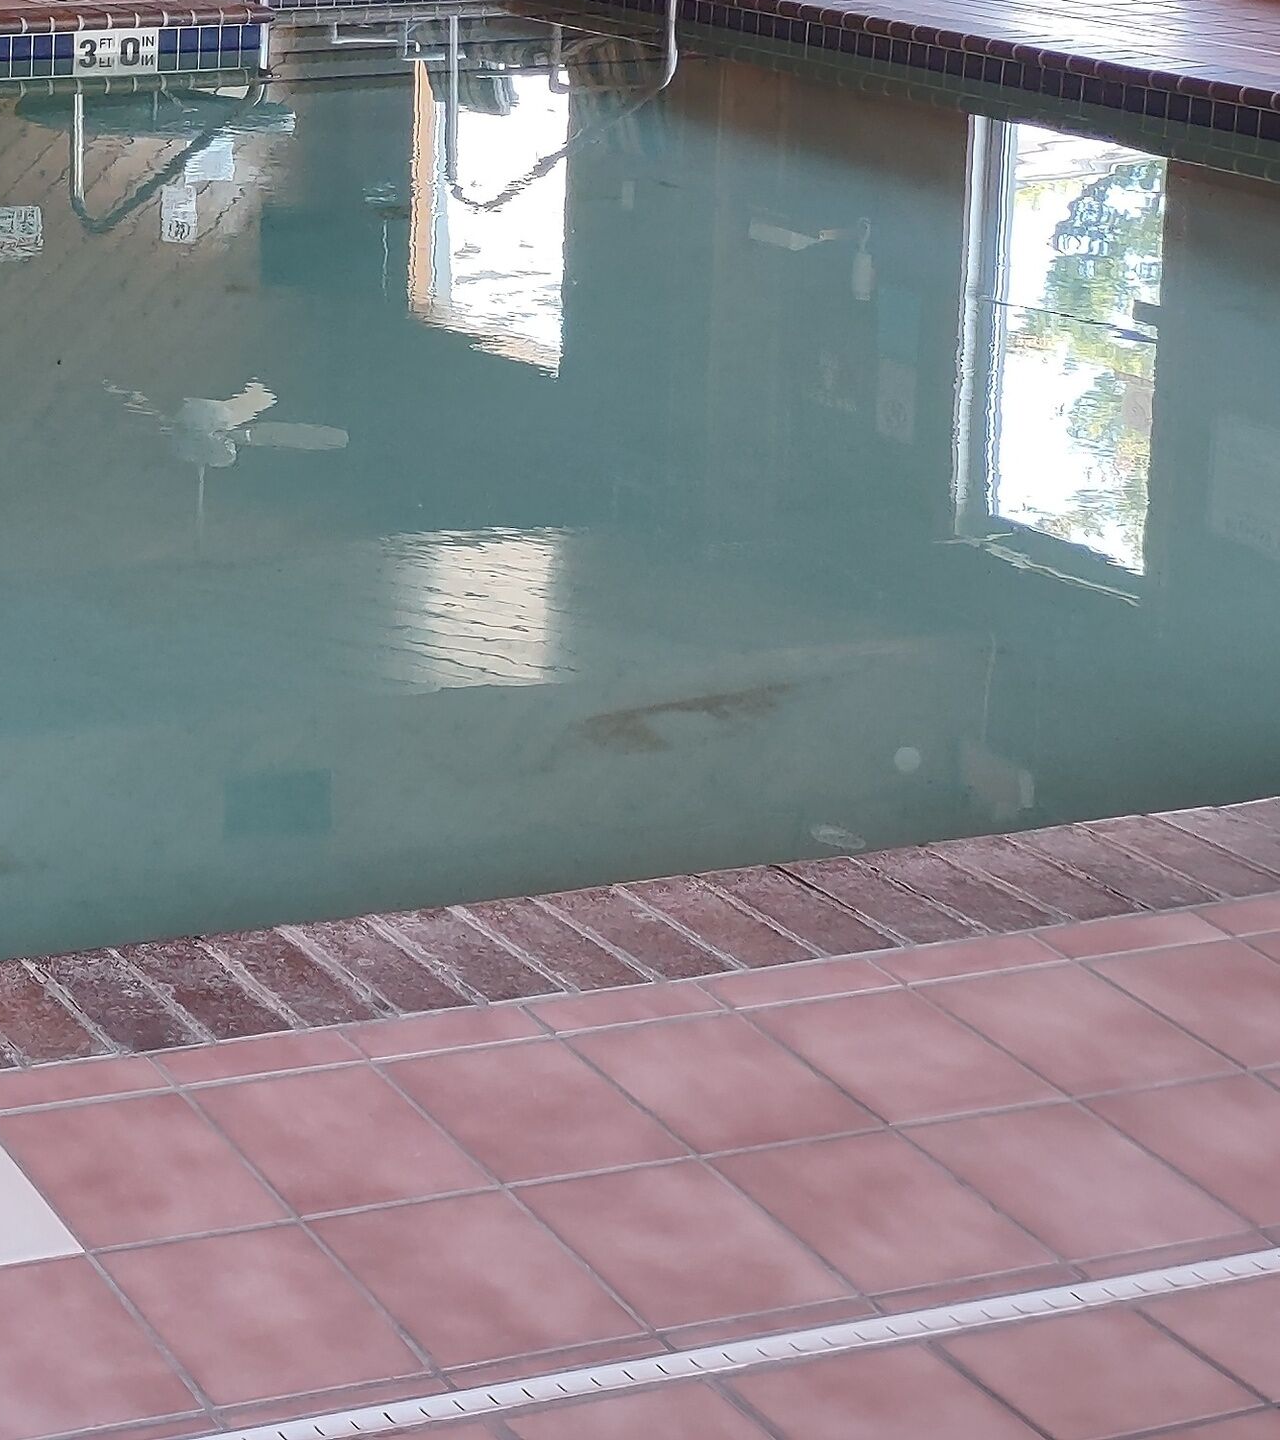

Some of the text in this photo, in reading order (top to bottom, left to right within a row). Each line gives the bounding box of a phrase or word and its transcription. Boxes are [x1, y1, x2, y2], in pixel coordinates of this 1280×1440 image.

[79, 36, 155, 68] 3 FT 0 IN
